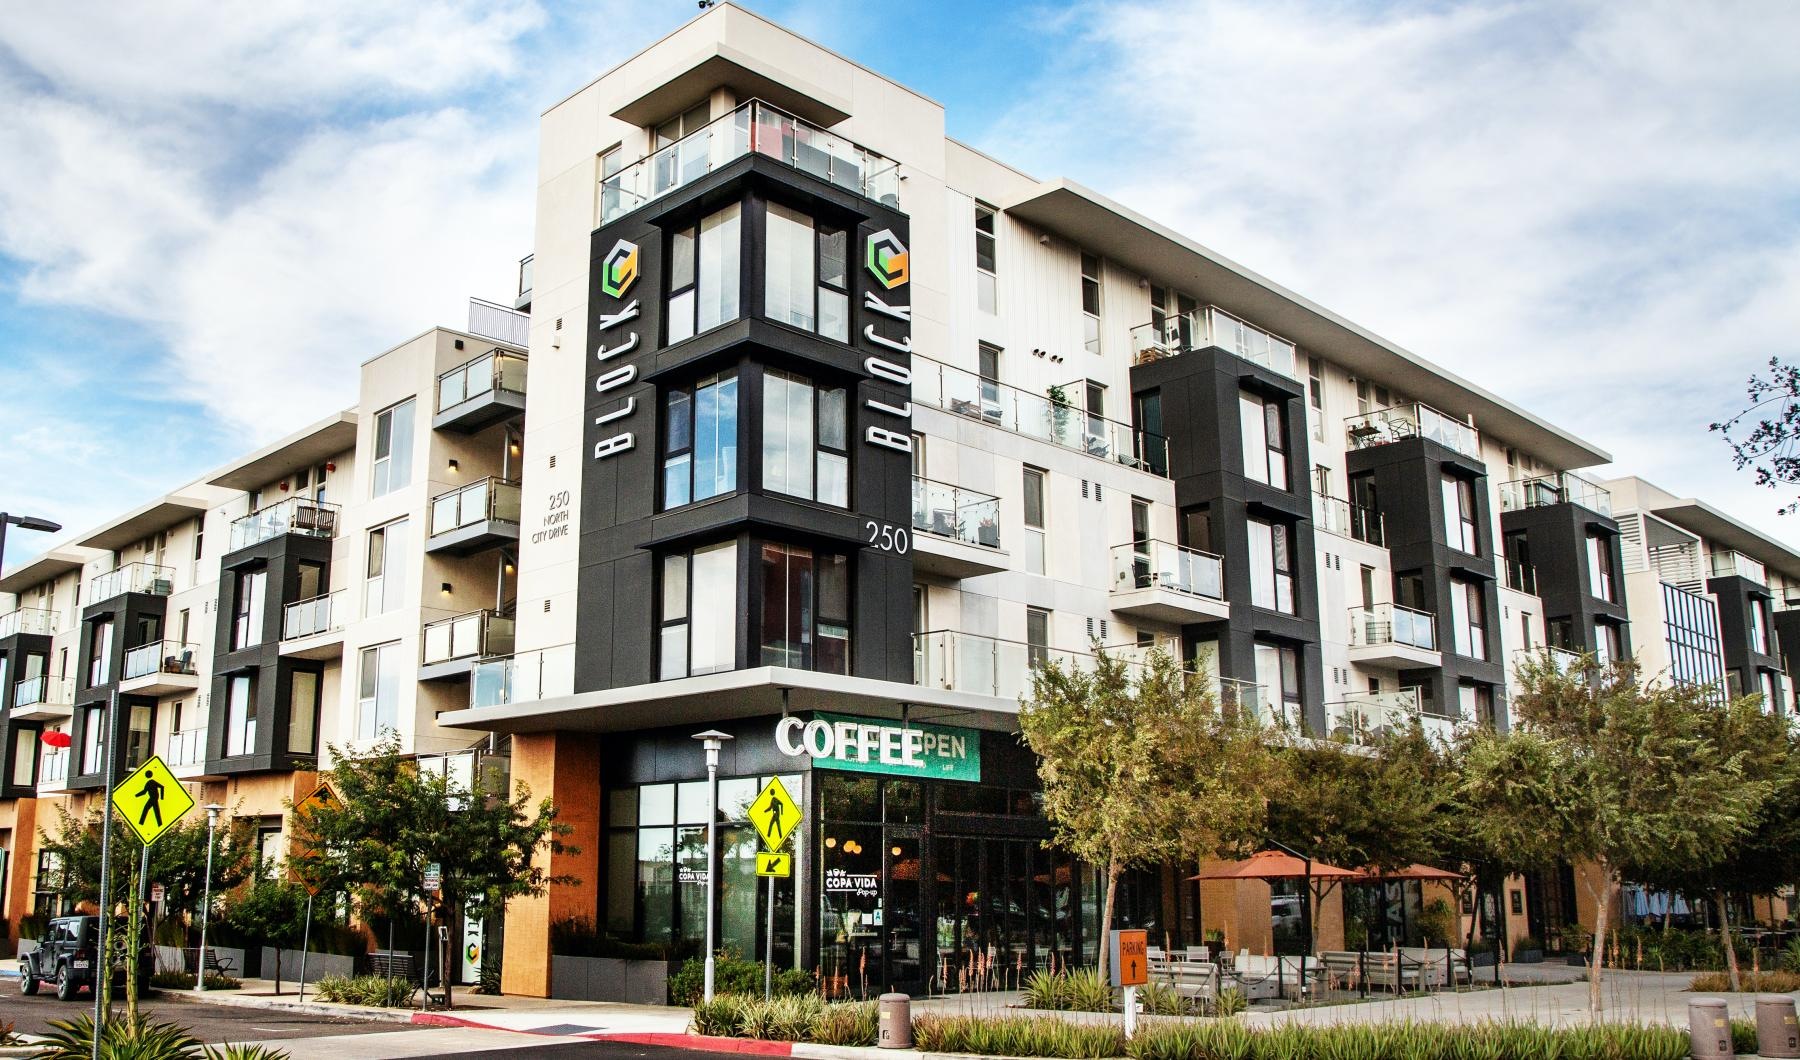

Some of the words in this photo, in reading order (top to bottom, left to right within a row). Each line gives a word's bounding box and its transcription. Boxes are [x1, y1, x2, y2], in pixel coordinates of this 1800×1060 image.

[595, 299, 640, 460] BLOCK
[864, 290, 912, 453] BLOCK
[549, 490, 570, 511] 250
[543, 509, 569, 527] NORTH
[532, 530, 548, 544] CITY
[548, 524, 569, 540] DRIVE
[866, 521, 908, 554] 250
[775, 716, 924, 768] COFFEE
[678, 872, 695, 880] COPA
[826, 877, 853, 888] COPA
[853, 877, 877, 888] VIDA
[1122, 941, 1145, 956] PARKING
